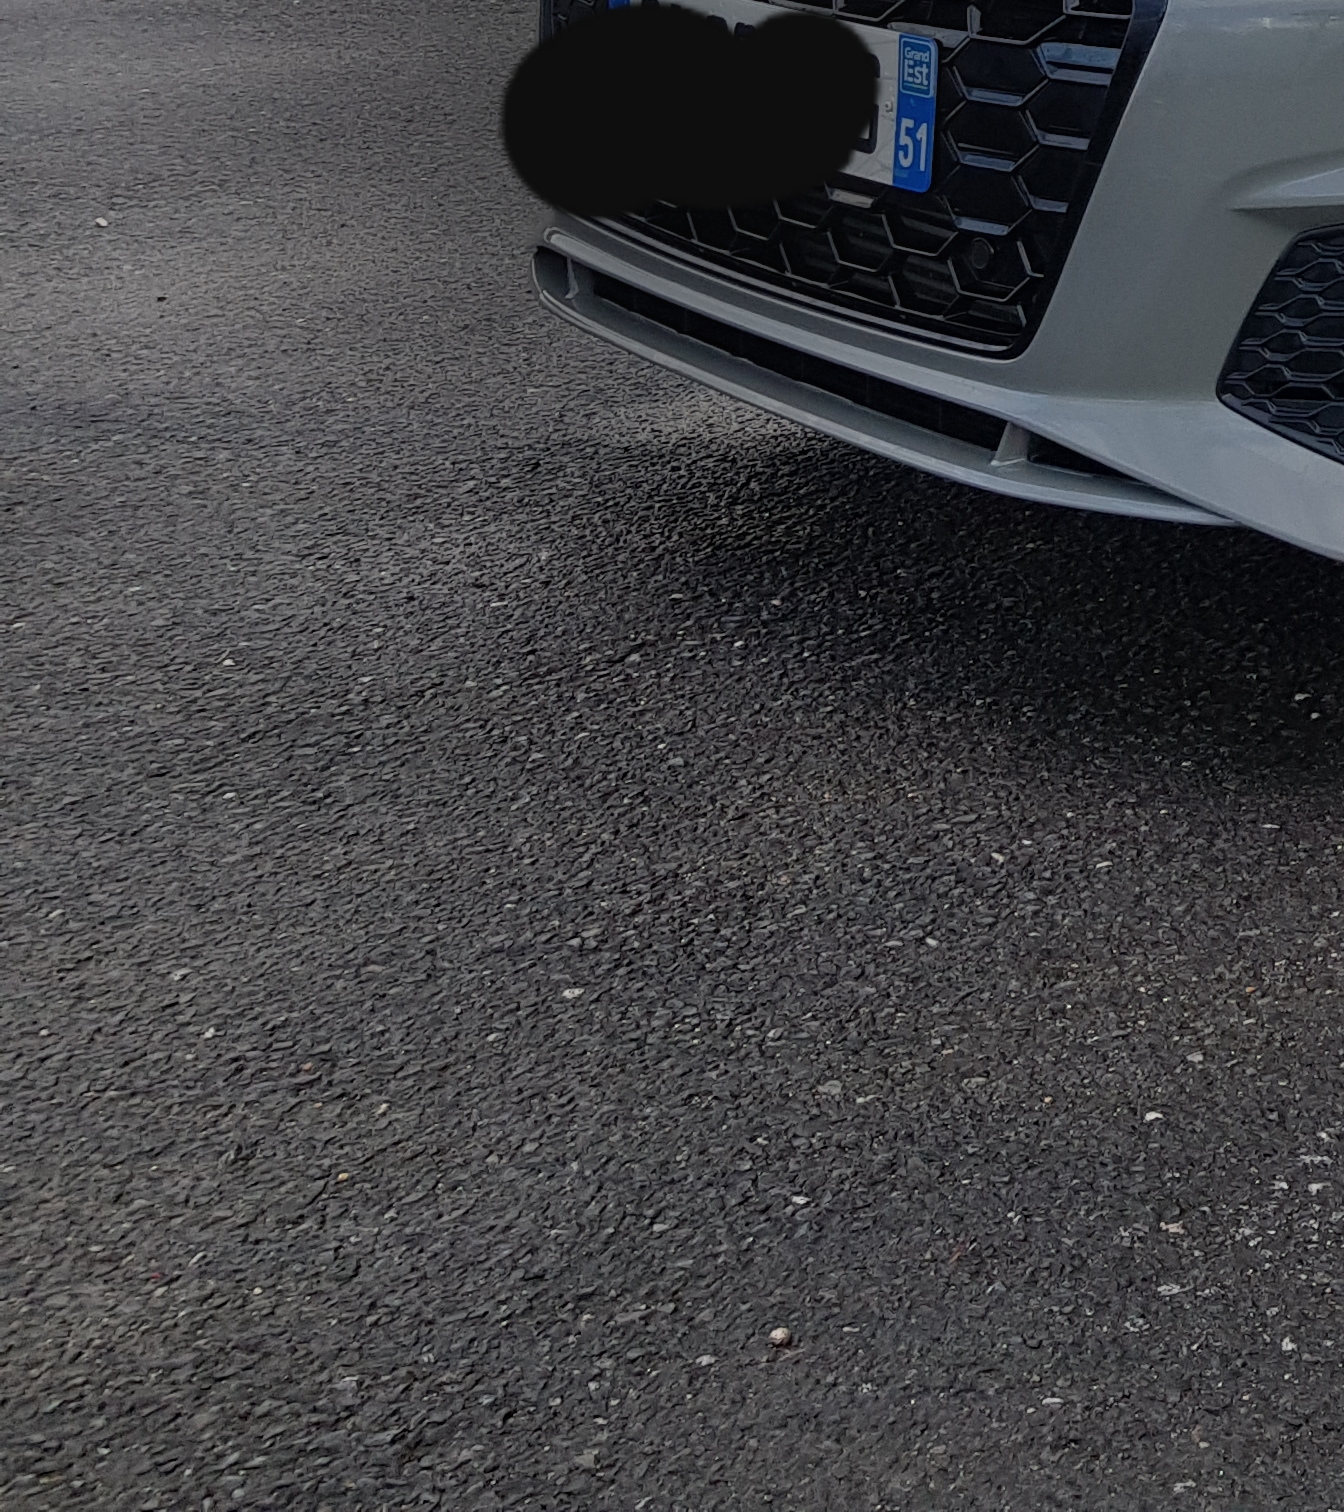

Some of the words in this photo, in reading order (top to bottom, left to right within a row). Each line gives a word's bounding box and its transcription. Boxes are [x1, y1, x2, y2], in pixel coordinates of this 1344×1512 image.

[904, 46, 930, 62] Grand
[904, 59, 929, 86] Est
[898, 117, 928, 172] 51
